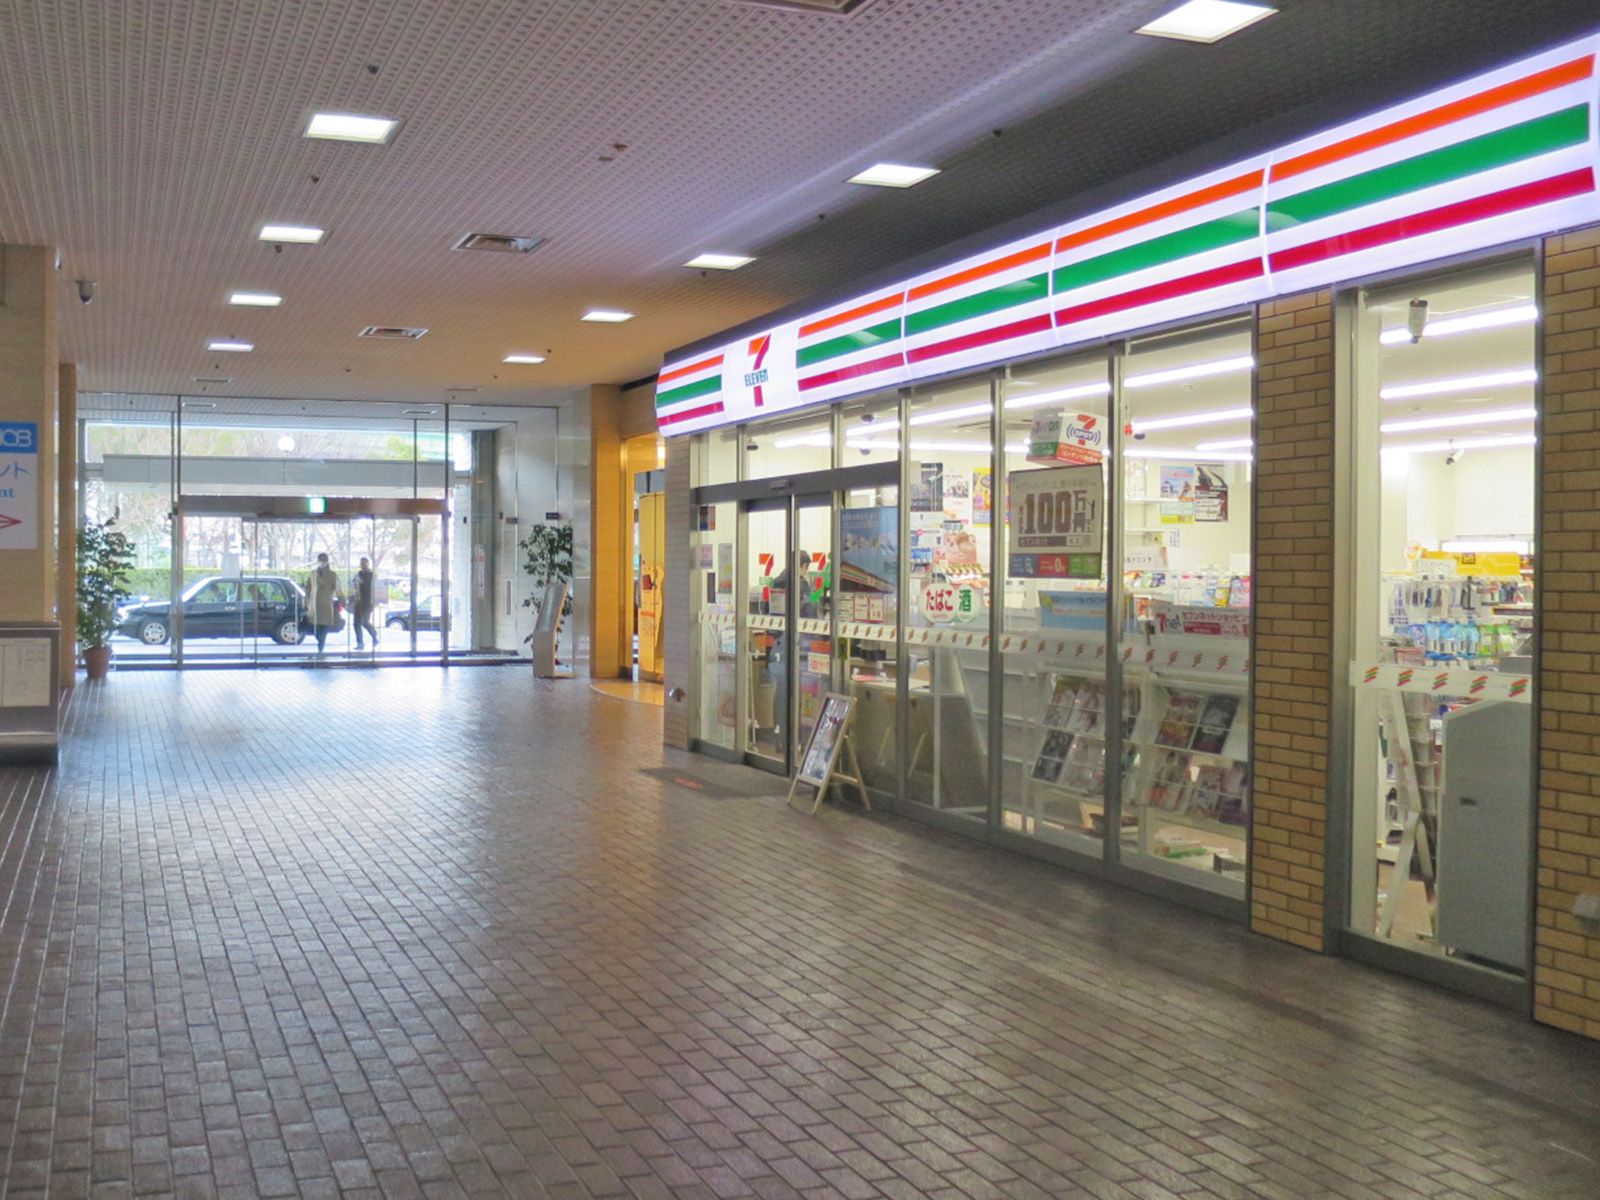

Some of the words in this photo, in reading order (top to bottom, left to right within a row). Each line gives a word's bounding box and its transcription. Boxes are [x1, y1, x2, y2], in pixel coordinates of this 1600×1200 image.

[748, 333, 771, 407] 7
[926, 589, 954, 612] たばこ
[959, 589, 971, 612] 酒
